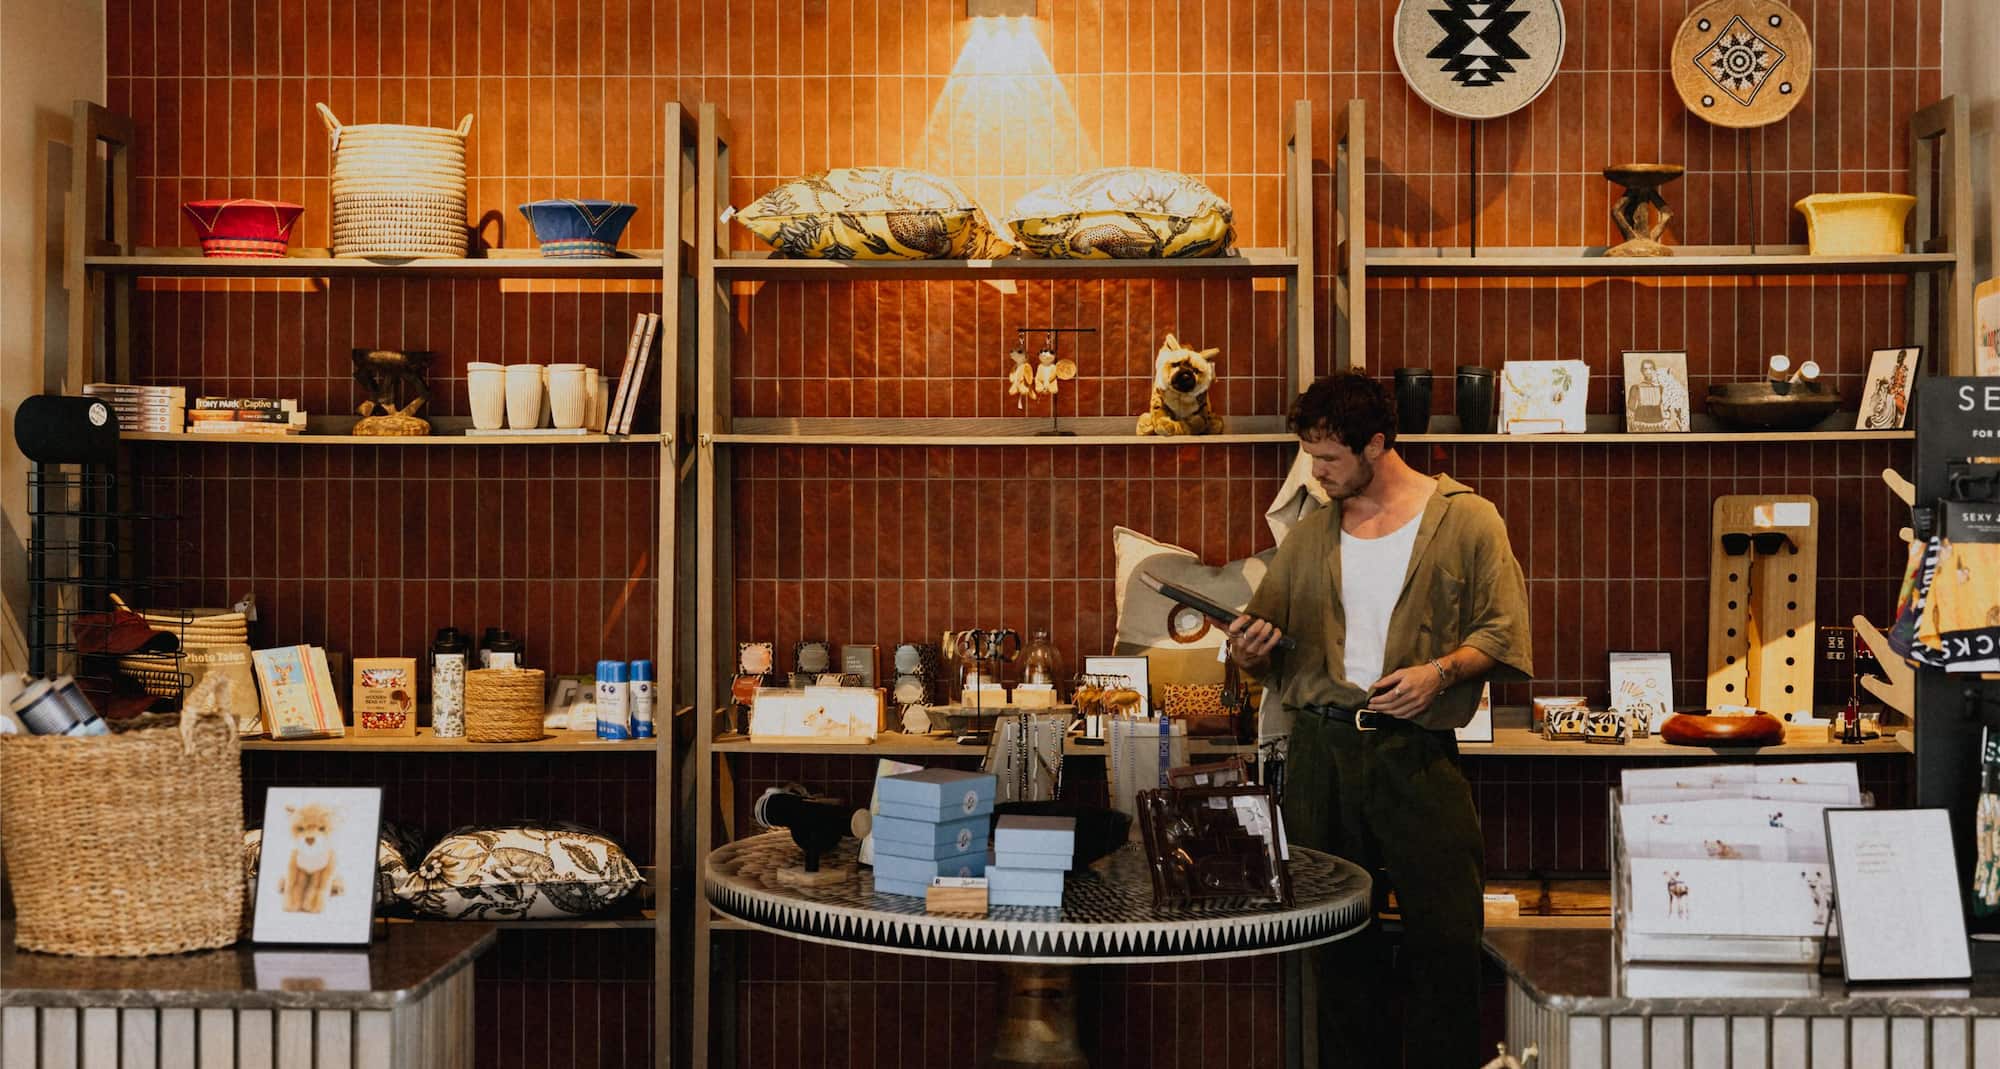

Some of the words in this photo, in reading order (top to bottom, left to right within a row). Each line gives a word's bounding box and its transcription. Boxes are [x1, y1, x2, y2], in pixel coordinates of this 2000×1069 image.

[200, 400, 218, 408] TONY
[219, 400, 240, 408] PARK
[244, 400, 272, 409] Captive
[1972, 430, 1993, 438] FOR
[1962, 512, 1992, 522] SEXY
[185, 653, 215, 663] Photo
